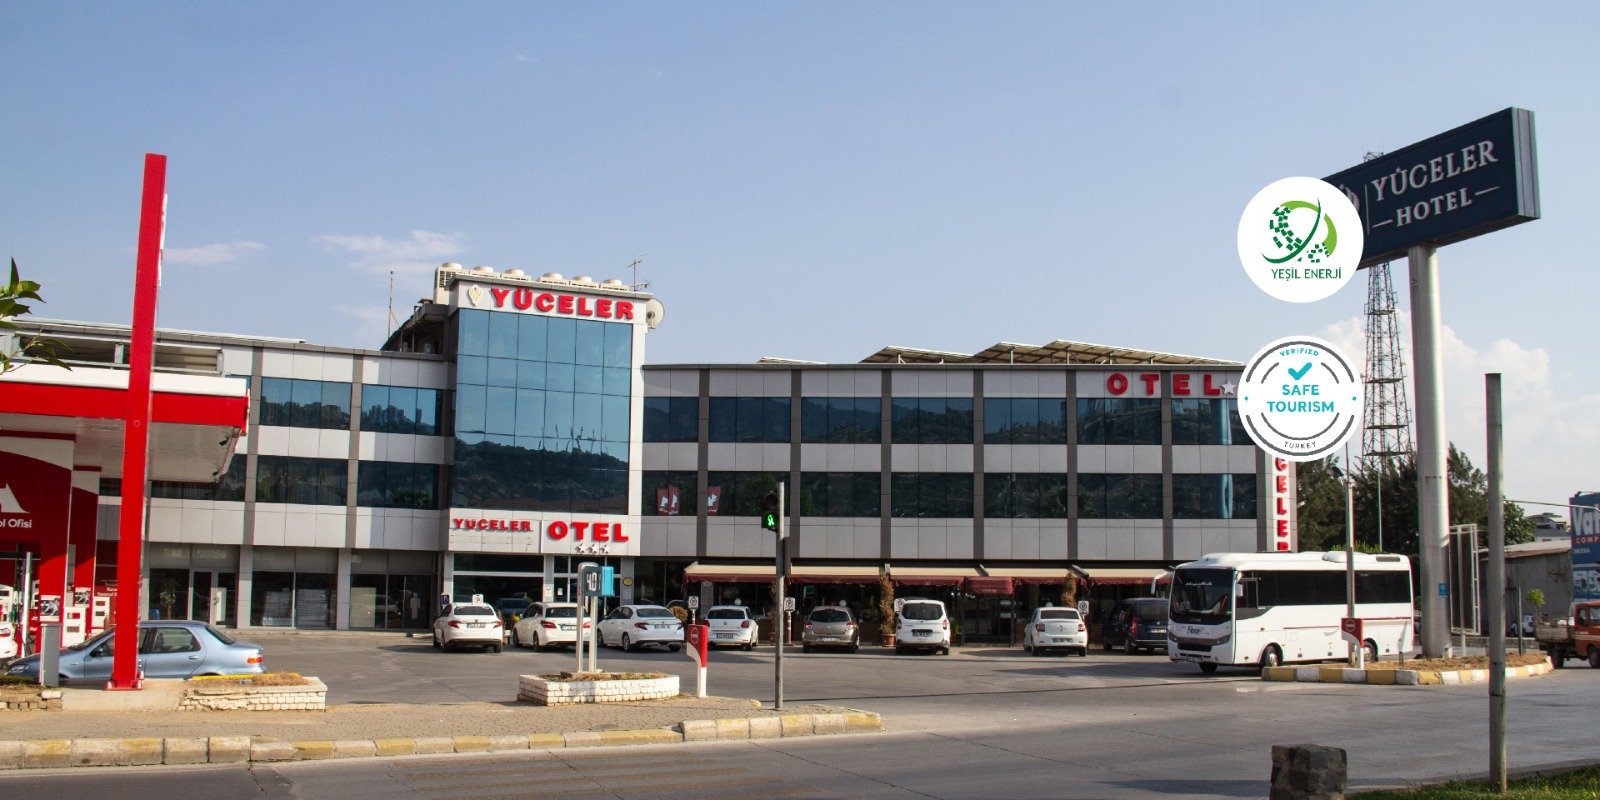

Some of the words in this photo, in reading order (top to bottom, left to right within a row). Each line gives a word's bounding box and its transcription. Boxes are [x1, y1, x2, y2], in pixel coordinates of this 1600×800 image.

[1371, 139, 1499, 202] YÜCELER
[1396, 191, 1474, 228] HOTEL
[491, 286, 635, 320] YÜCELER
[1107, 372, 1221, 396] OTEL
[7, 518, 33, 529] Ofisi
[548, 521, 629, 542] OTEL
